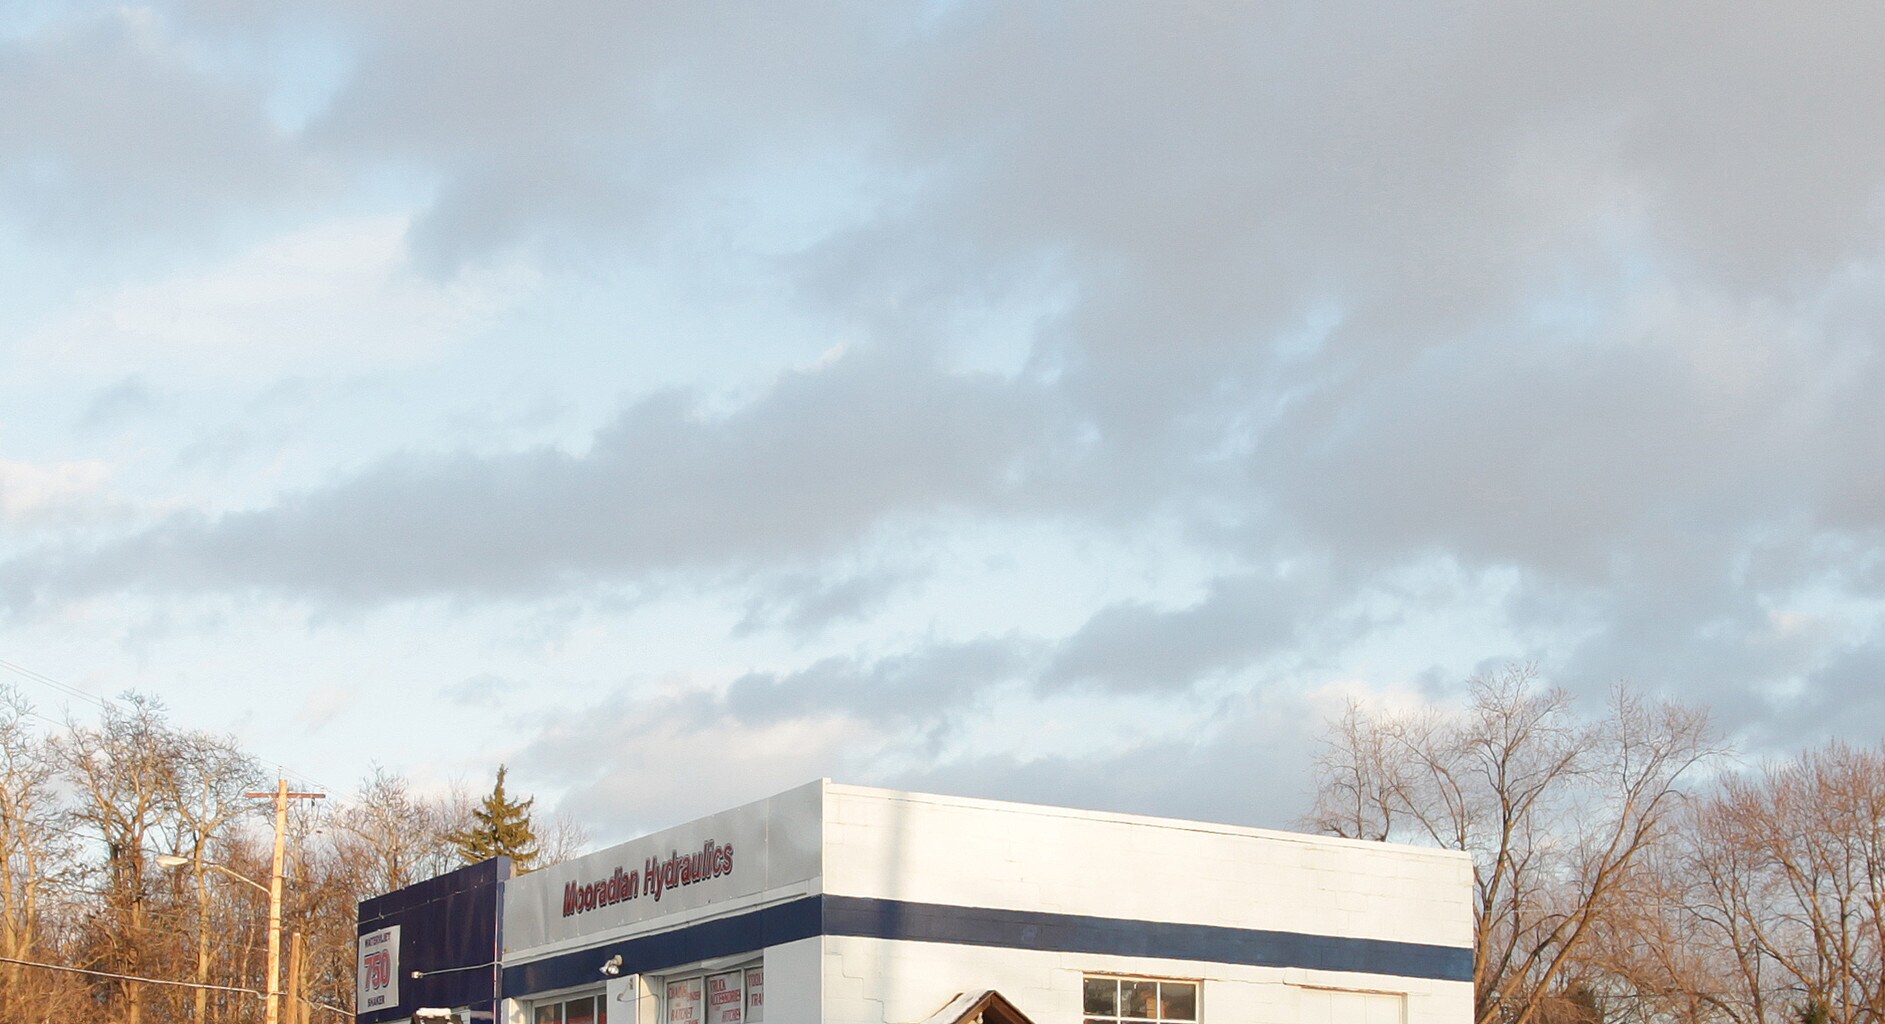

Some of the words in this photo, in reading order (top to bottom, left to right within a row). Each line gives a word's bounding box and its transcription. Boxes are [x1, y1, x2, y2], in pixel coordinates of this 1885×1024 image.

[562, 866, 640, 917] Mooradian
[643, 838, 735, 902] Hydraulics
[364, 949, 391, 991] 750
